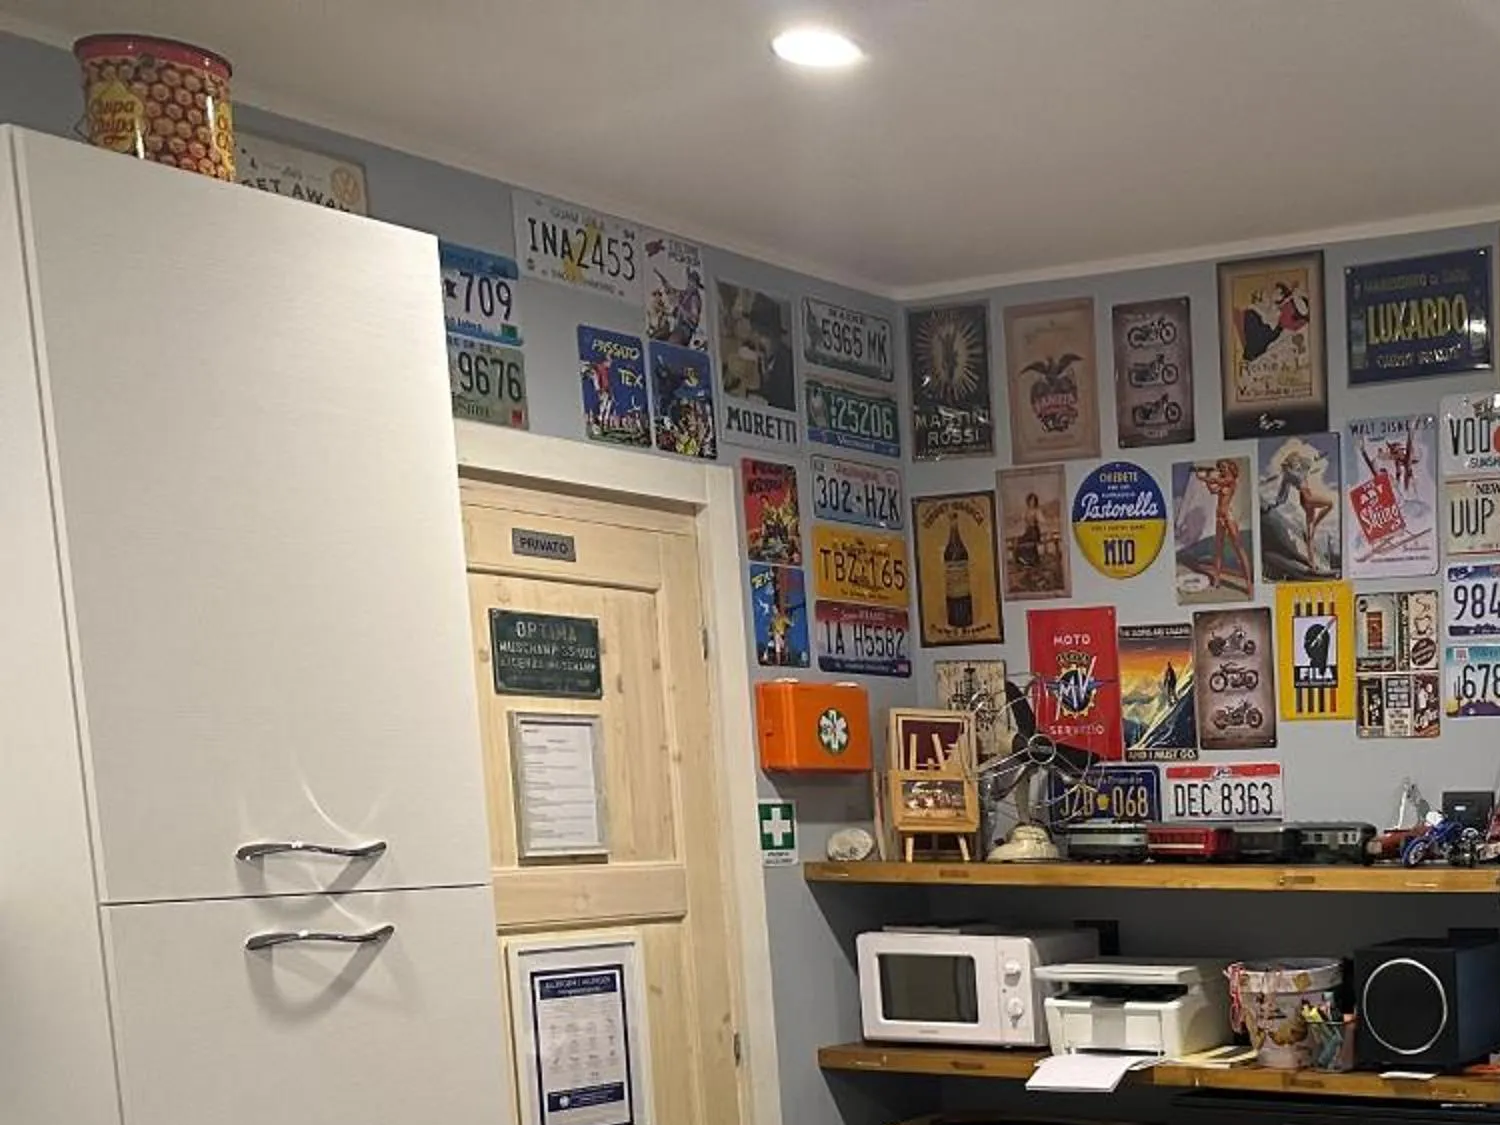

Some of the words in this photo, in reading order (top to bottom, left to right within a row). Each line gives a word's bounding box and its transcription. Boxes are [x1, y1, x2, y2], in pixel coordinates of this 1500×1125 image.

[527, 216, 636, 282] INA2453
[459, 270, 513, 322] 709
[1366, 292, 1468, 346] LUXARDO
[820, 317, 864, 360] 5965
[457, 351, 523, 403] 9676
[617, 367, 645, 389] TEX
[726, 405, 798, 444] MORETTI
[926, 430, 981, 447] ROSSI
[816, 475, 852, 514] 302
[1080, 489, 1159, 521] Pastorella
[1475, 482, 1500, 495] NEW
[1451, 500, 1496, 538] UUP
[519, 537, 569, 555] PRIVATO
[1053, 633, 1092, 647] MOTO
[1299, 667, 1334, 682] FILA
[1112, 785, 1148, 818] 068
[1174, 784, 1212, 817] DEC
[1220, 782, 1275, 817] 8363
